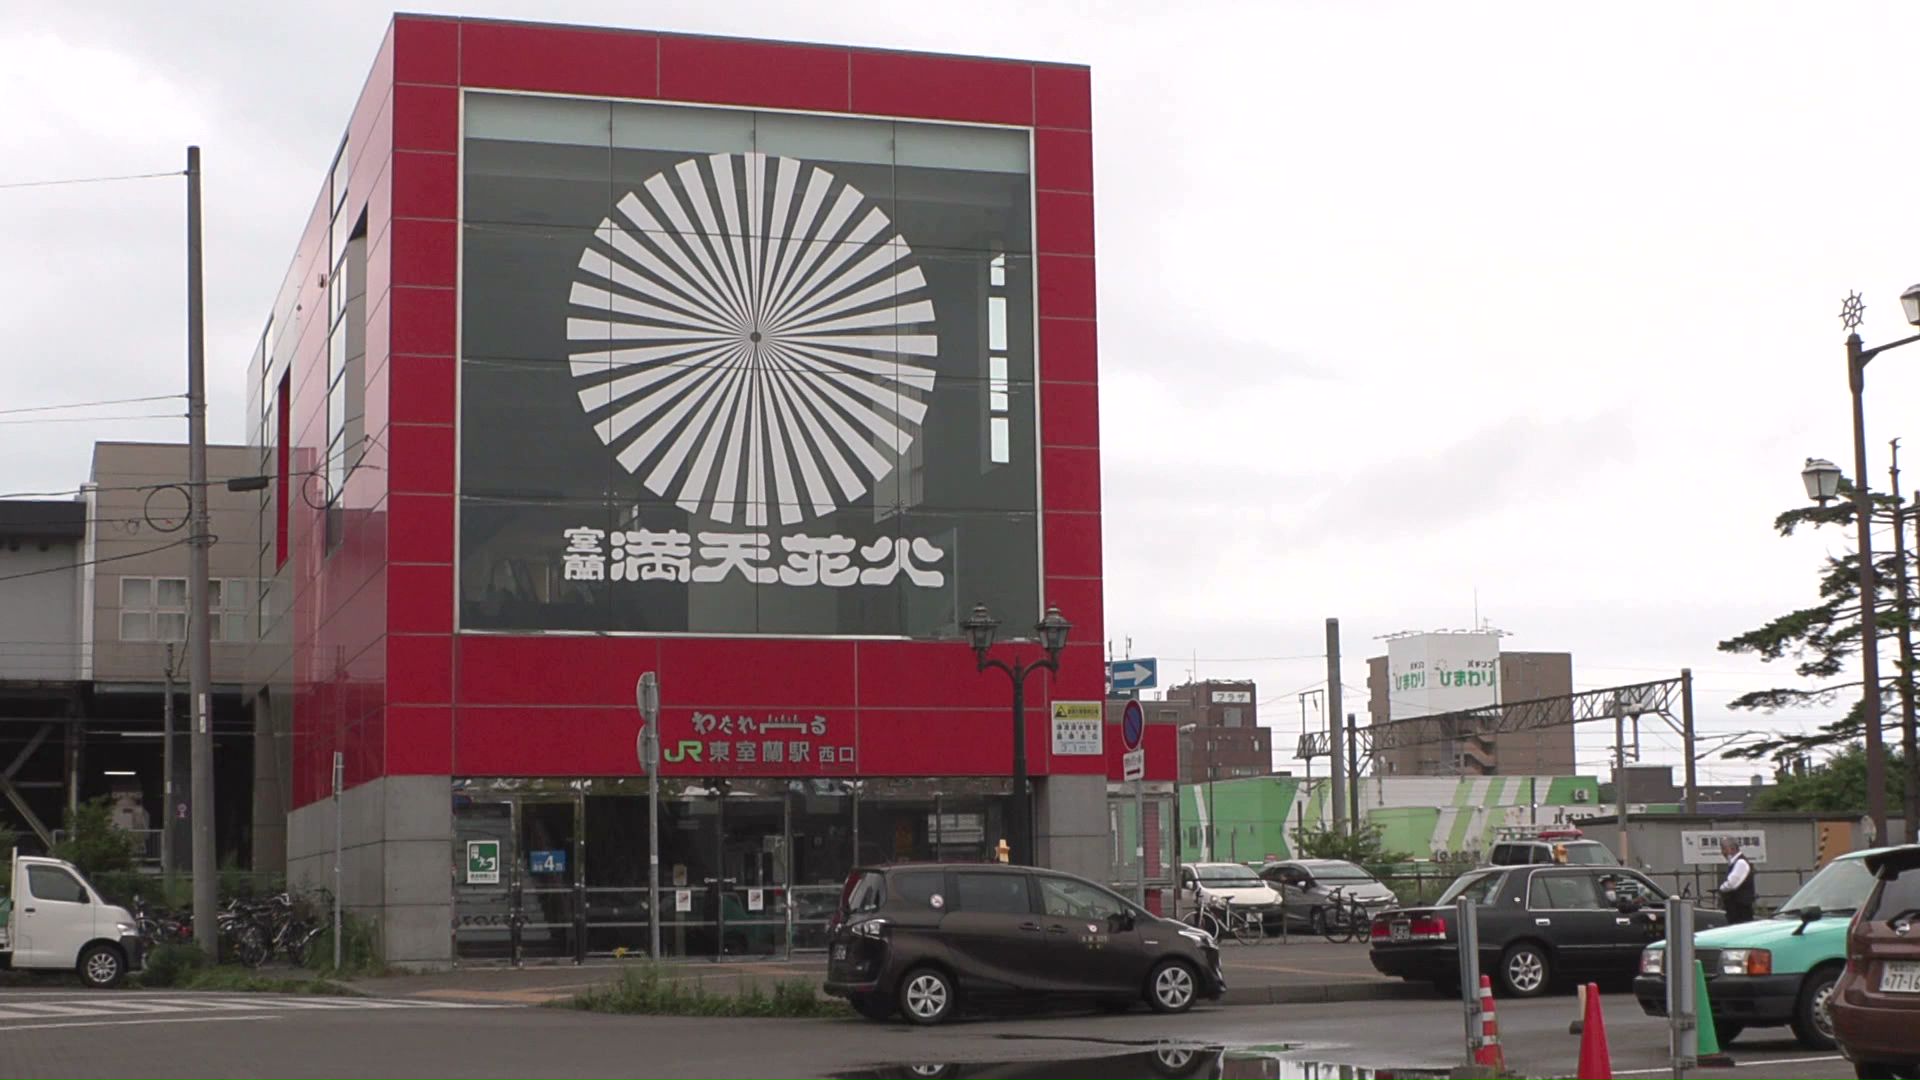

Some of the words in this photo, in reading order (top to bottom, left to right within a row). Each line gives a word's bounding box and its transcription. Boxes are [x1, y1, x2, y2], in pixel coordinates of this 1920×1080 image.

[1440, 670, 1494, 687] ひまわり
[664, 741, 703, 762] JR
[709, 741, 810, 762] 東室蘭駅
[819, 746, 855, 762] 西口
